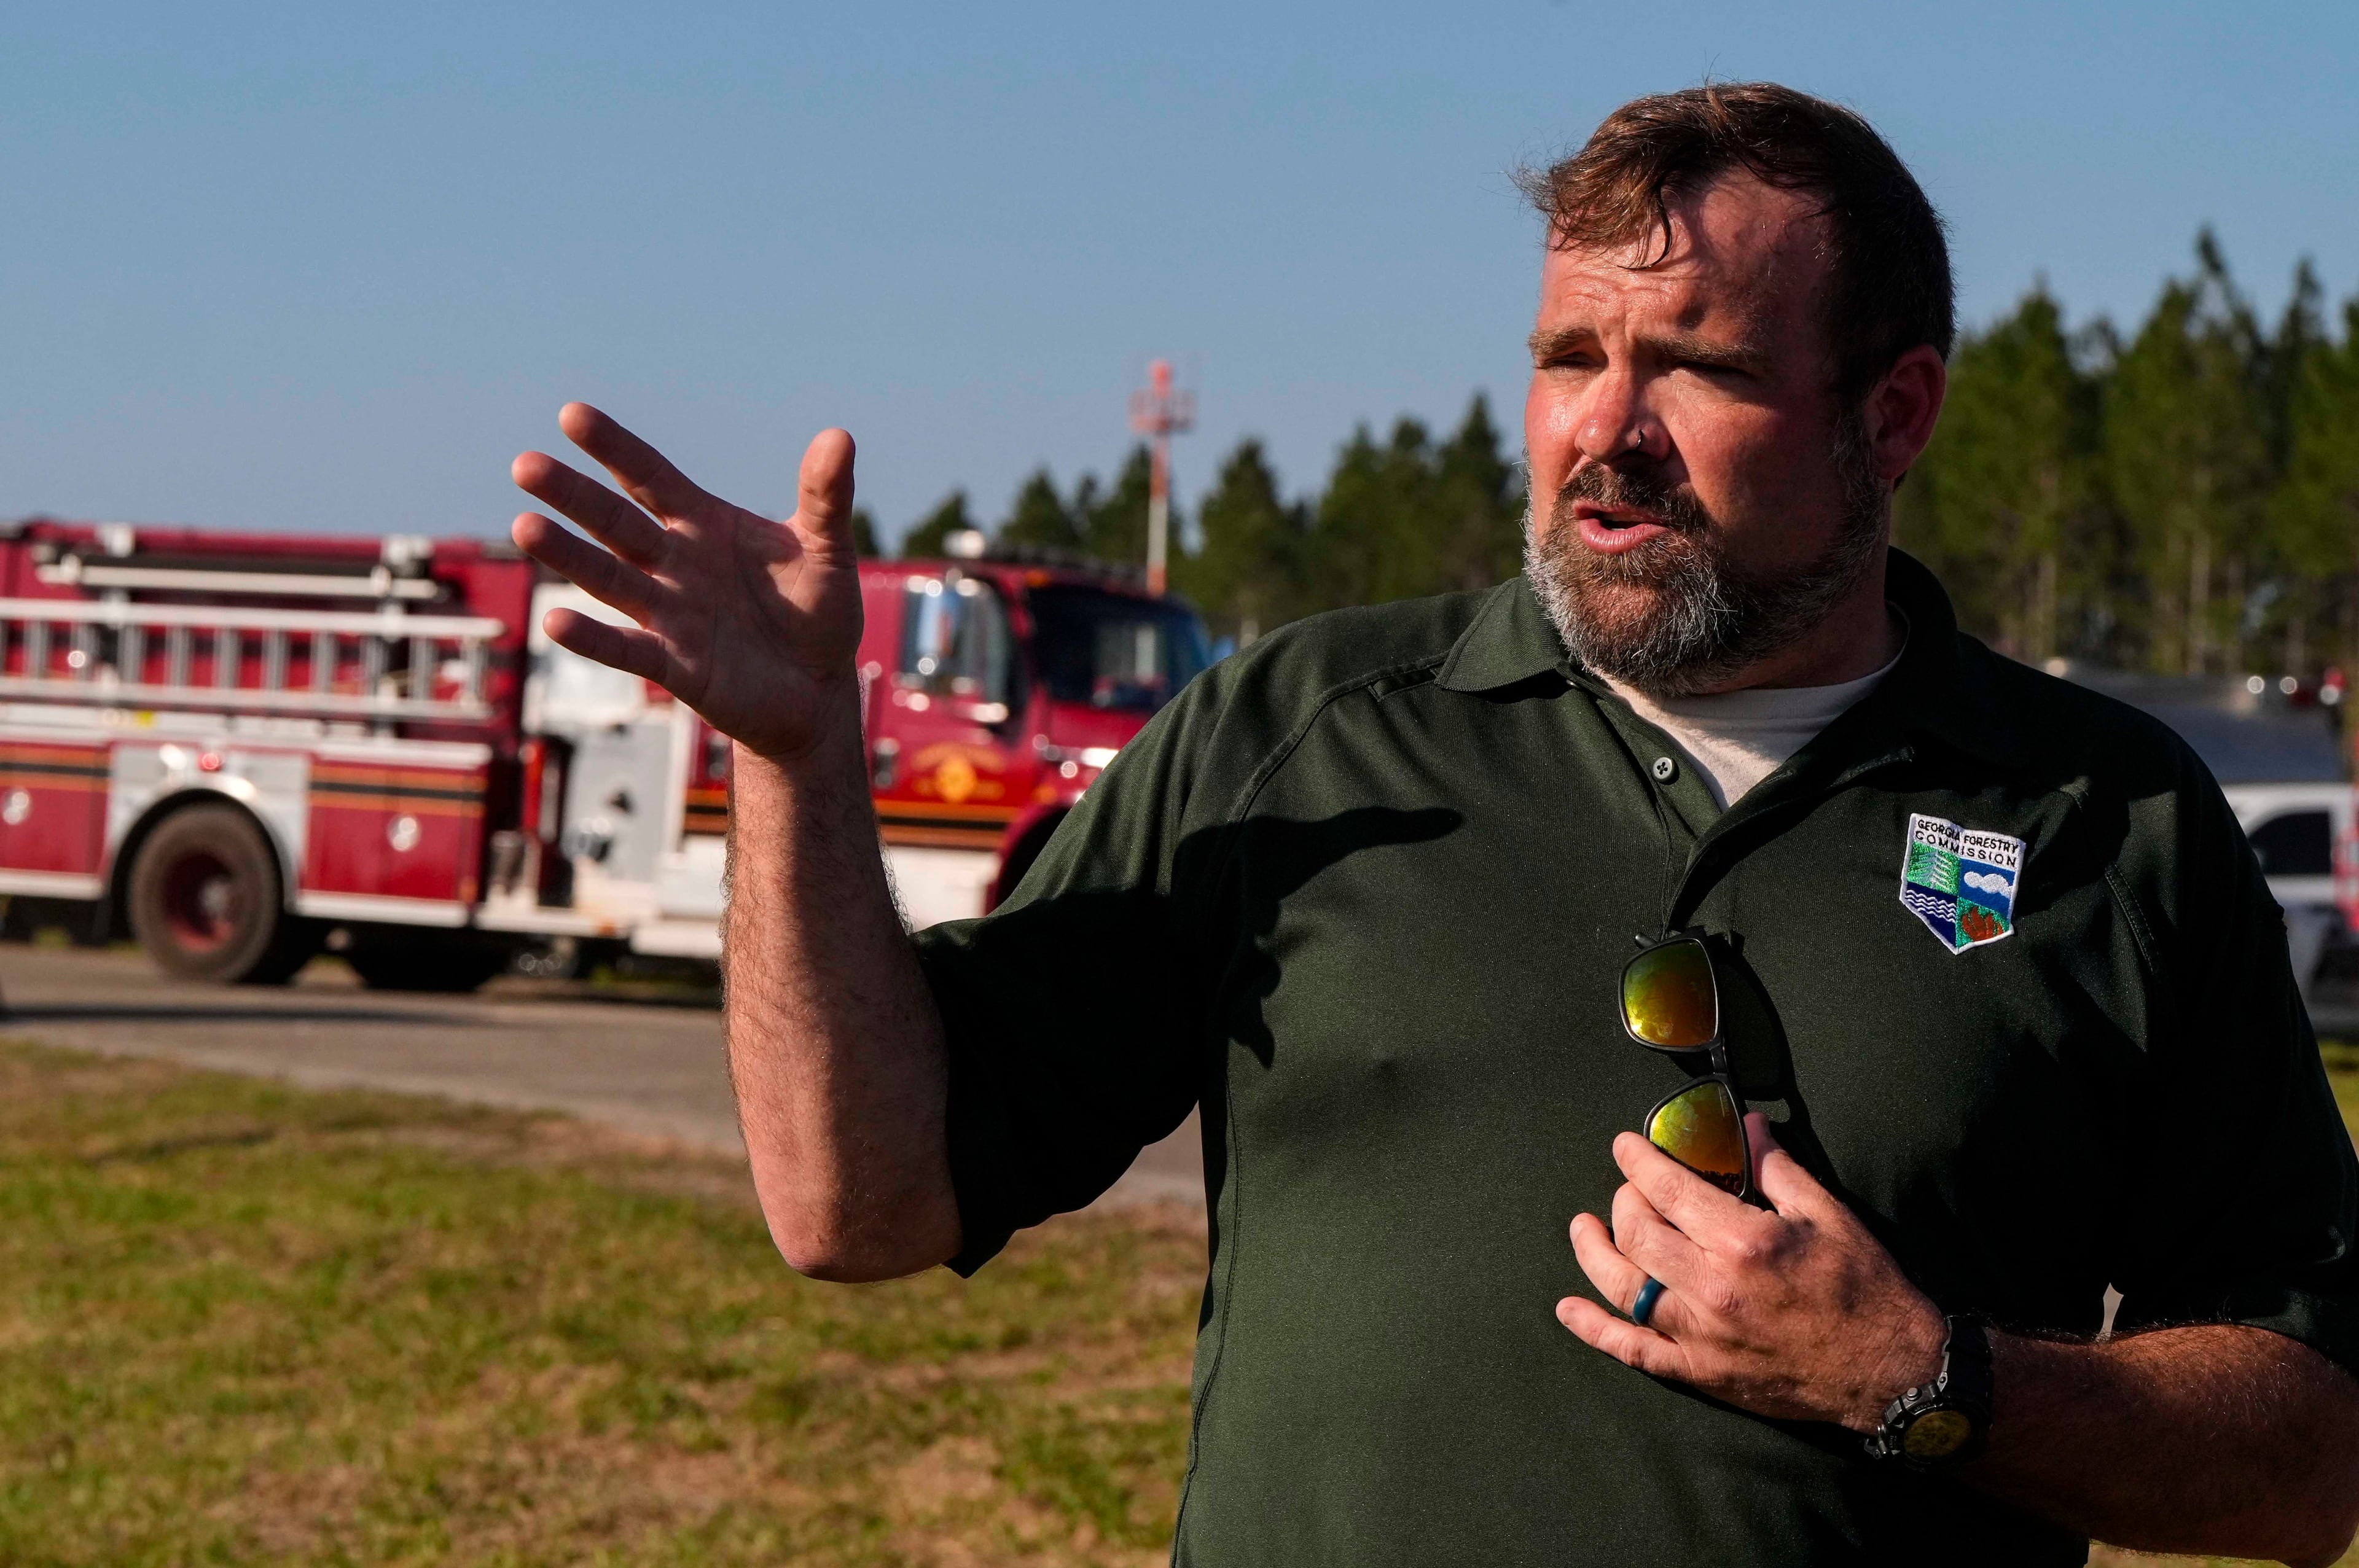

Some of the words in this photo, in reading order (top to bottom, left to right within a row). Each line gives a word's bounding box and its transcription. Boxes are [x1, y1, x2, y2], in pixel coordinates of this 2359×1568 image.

[1915, 830, 2016, 867] COMMISSION
[1918, 819, 1960, 841] GEORGIA
[1964, 835, 2019, 854] FORESTRY
